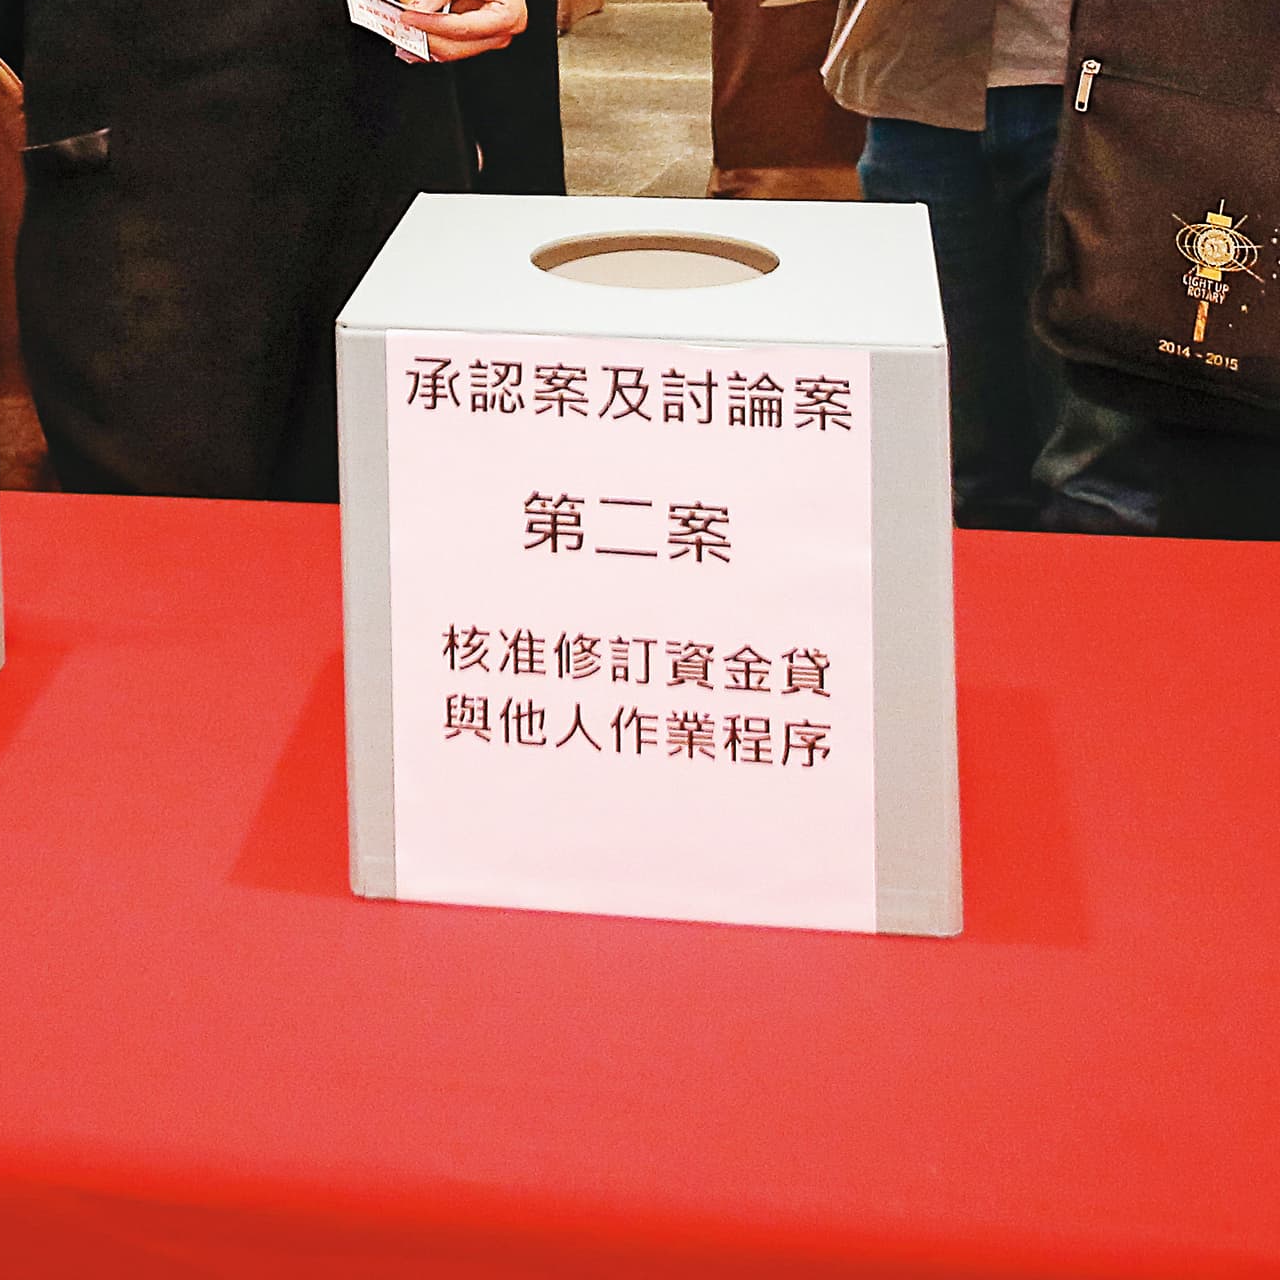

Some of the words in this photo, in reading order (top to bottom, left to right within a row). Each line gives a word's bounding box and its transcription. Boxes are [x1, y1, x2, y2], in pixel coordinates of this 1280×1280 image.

[1182, 274, 1214, 290] LIGHT
[1215, 281, 1230, 294] UP
[1187, 285, 1226, 305] ROTARY
[405, 356, 853, 432] 承認案及討論案
[523, 490, 732, 564] 第二案
[441, 623, 832, 699] 核准修訂資金貸
[443, 693, 833, 768] 與他人作業程序
